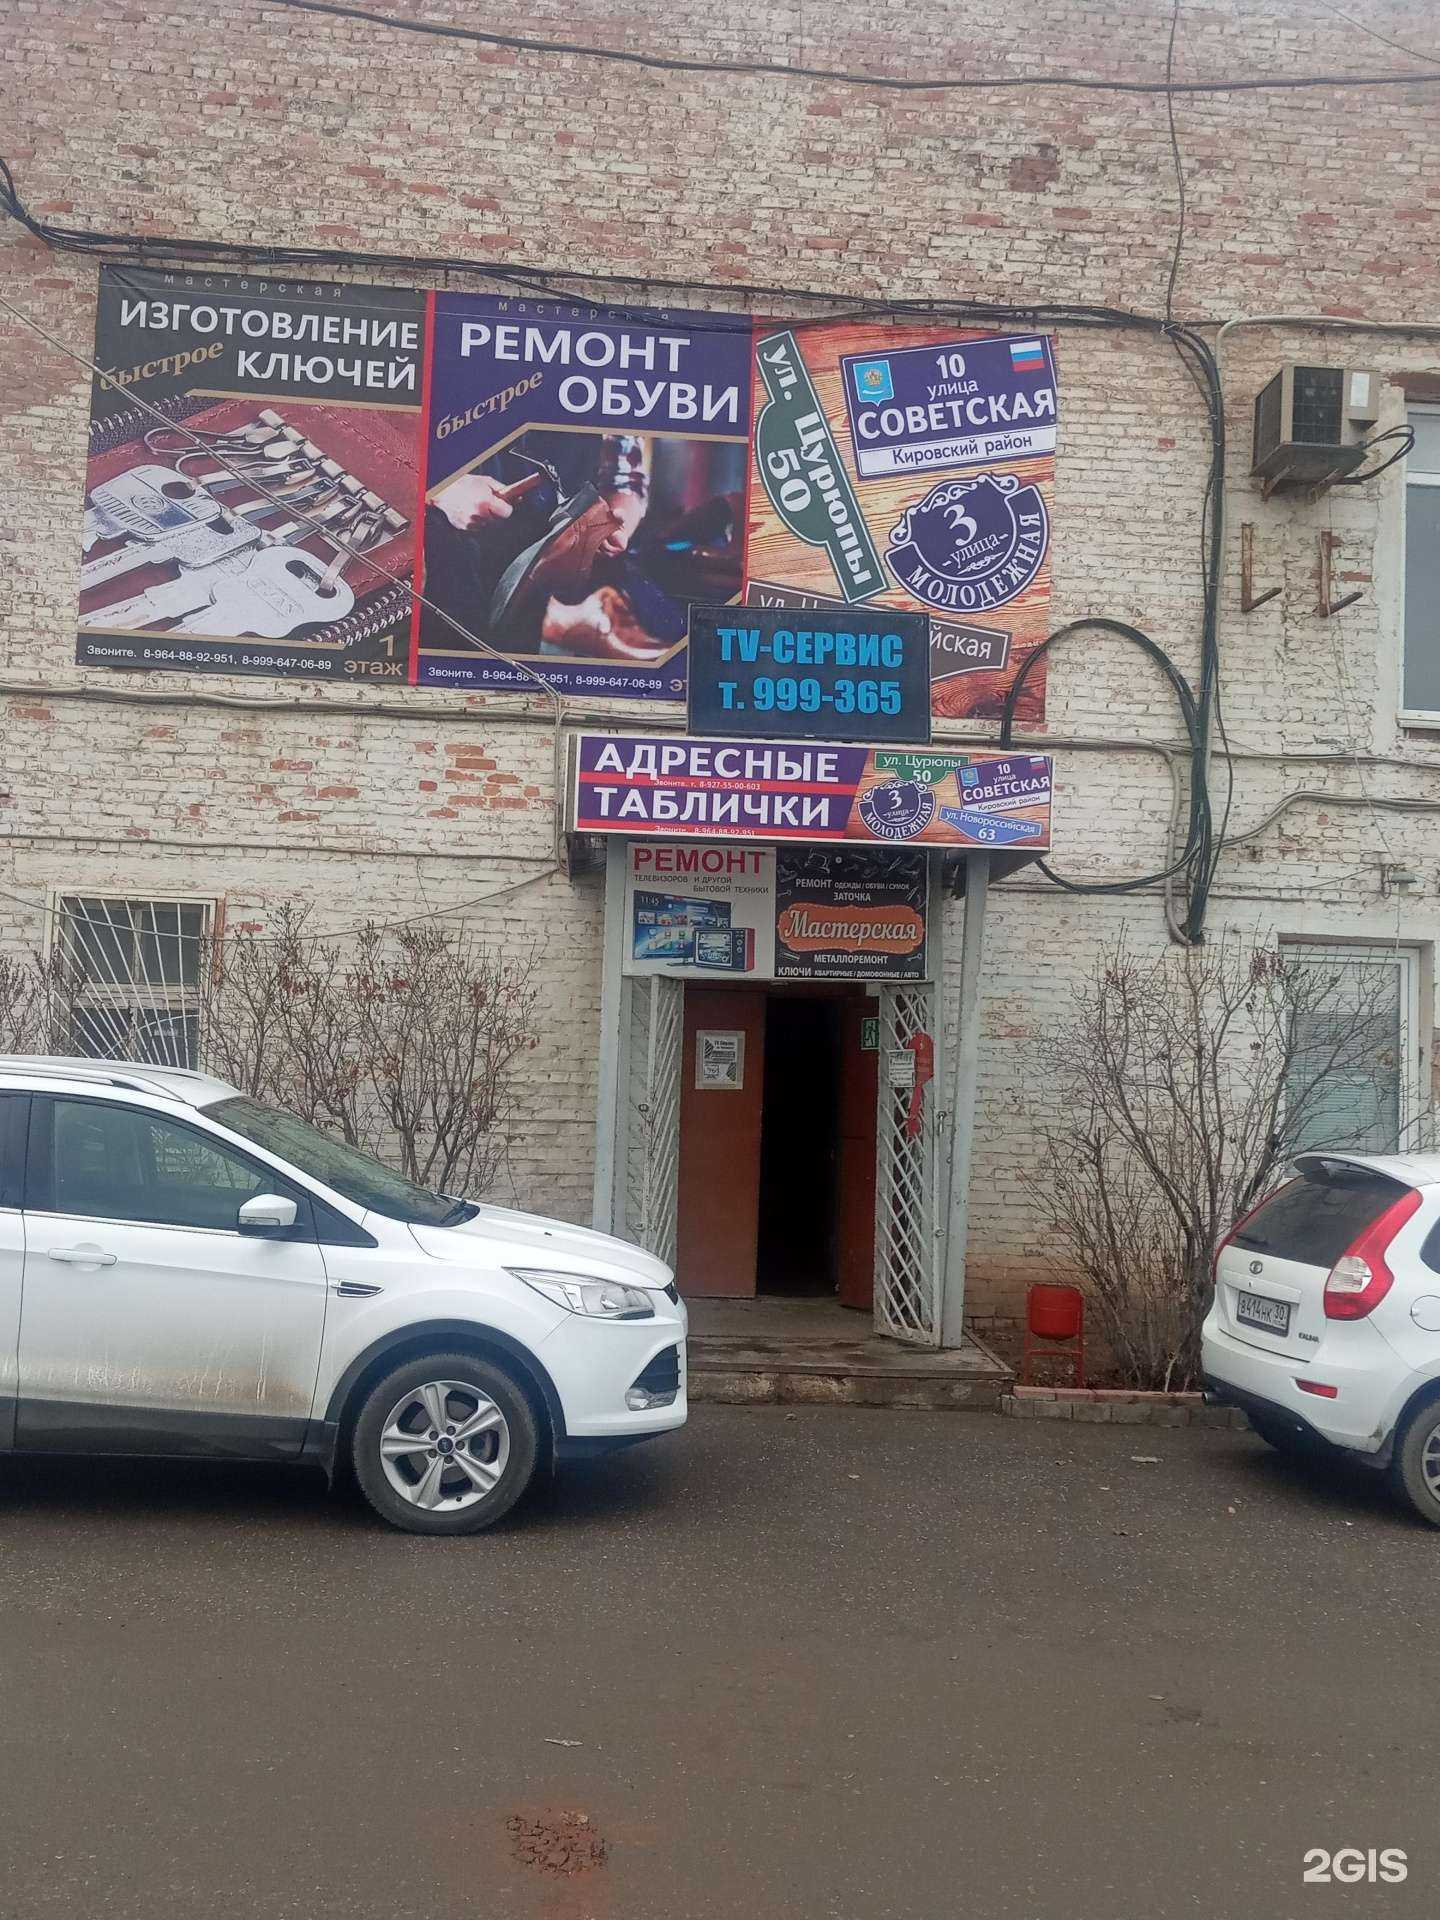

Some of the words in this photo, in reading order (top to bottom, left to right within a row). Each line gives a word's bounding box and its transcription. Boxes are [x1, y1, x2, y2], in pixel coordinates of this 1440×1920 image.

[164, 273, 343, 298] мастерская
[120, 299, 419, 350] ИЗГОТОВЛЕНИЕ
[460, 322, 691, 372] РЕМОНТ
[99, 340, 225, 391] быстрое
[237, 350, 416, 390] КЛЮЧЕЙ
[764, 343, 798, 400] ул.
[936, 354, 966, 379] 10
[558, 375, 739, 423] ОБУВИ
[927, 379, 979, 401] улица
[436, 371, 543, 440] быстрое
[858, 388, 1056, 440] СОВЕТСКАЯ
[893, 438, 979, 465] Кировский
[985, 434, 1032, 457] район
[767, 450, 811, 512] 50
[795, 411, 872, 585] Цурюпы
[943, 504, 977, 547] 3
[906, 511, 1041, 608] МОЛОДЕЖНАЯ
[379, 634, 394, 657] 1
[717, 628, 902, 668] TV-СЕРВИС
[242, 654, 332, 670] 8-999-647-06-89
[344, 658, 404, 677] этаж
[576, 676, 662, 690] 8-999-647-06-89
[753, 677, 902, 715] 999-365
[594, 743, 839, 783] АДРЕСНЫЕ
[883, 756, 901, 767] ул.
[904, 755, 961, 769] Цурюпы
[997, 764, 1011, 775] 10
[913, 770, 932, 783] 50
[962, 776, 1051, 802] СОВЕТСКАЯ
[992, 773, 1016, 785] улица
[593, 787, 830, 827] ТАБЛИЧКИ
[888, 790, 903, 810] 3
[863, 802, 933, 840] МОЛОДЕЖНАЯ
[945, 811, 959, 821] ул.
[960, 813, 1036, 834] Новороссийская
[978, 827, 996, 840] 63
[634, 847, 767, 874] РЕМОНТ
[634, 874, 688, 884] ТЕЛЕВИЗОРОВ
[702, 876, 732, 885] ДРУГОЙ
[693, 884, 731, 893] БЫТОВОЙ
[735, 886, 769, 894] ТЕХНИКИ
[795, 878, 832, 888] РЕМОНТ
[833, 892, 871, 901] ЗАТОЧКА
[785, 910, 917, 946] Мастерская
[778, 967, 811, 977] КЛЮЧИ
[814, 954, 888, 965] МЕТАЛЛОРЕМОНТ
